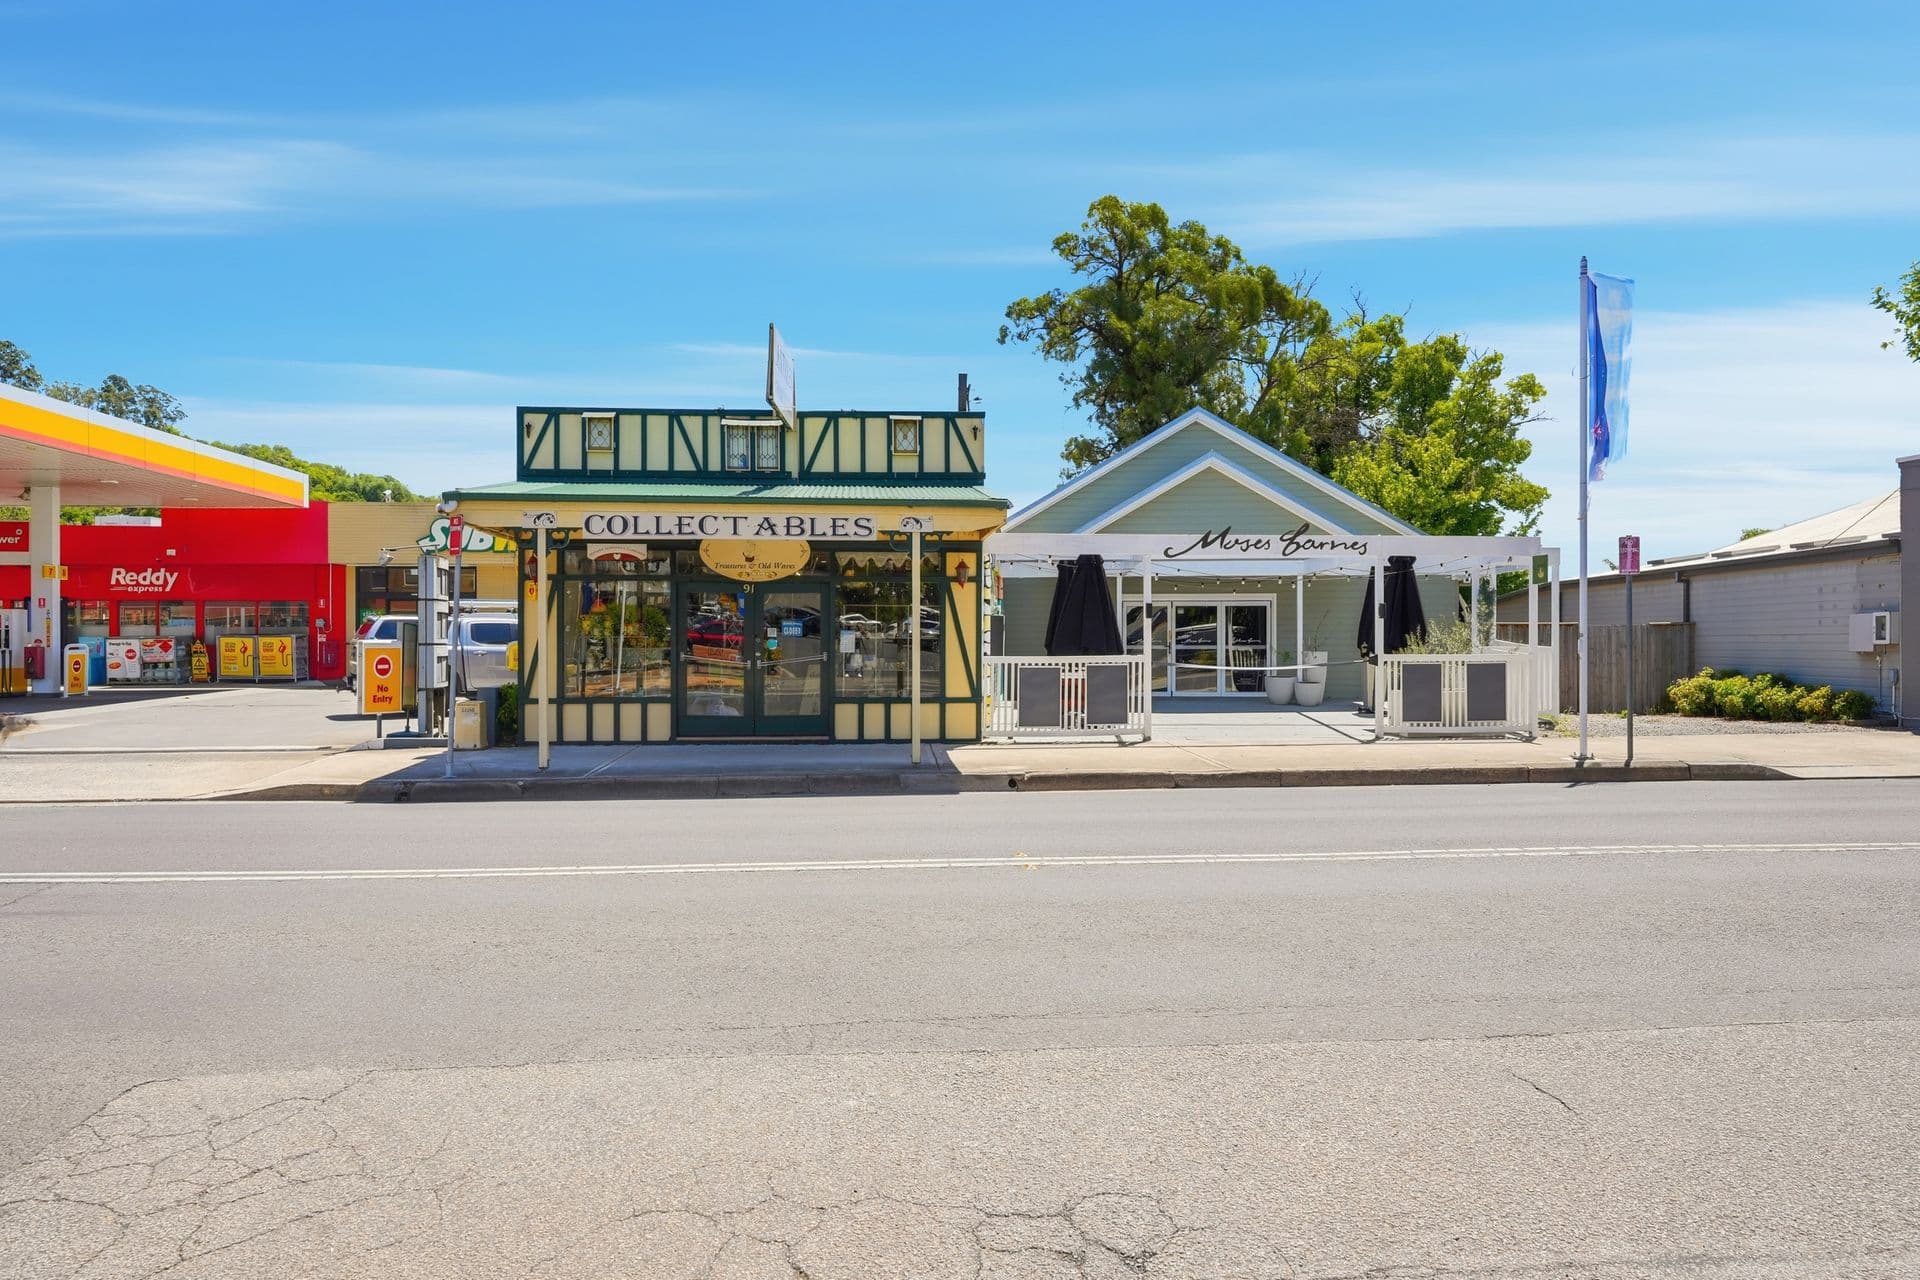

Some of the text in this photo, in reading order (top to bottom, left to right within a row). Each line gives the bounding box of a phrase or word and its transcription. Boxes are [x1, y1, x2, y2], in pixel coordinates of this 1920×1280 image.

[584, 514, 873, 536] COLLECTABLES
[1164, 522, 1368, 558] Moses Barnes
[110, 567, 179, 592] Reddy
[127, 585, 163, 594] express
[743, 584, 755, 593] 91
[377, 684, 389, 693] No
[372, 694, 393, 705] Entry
